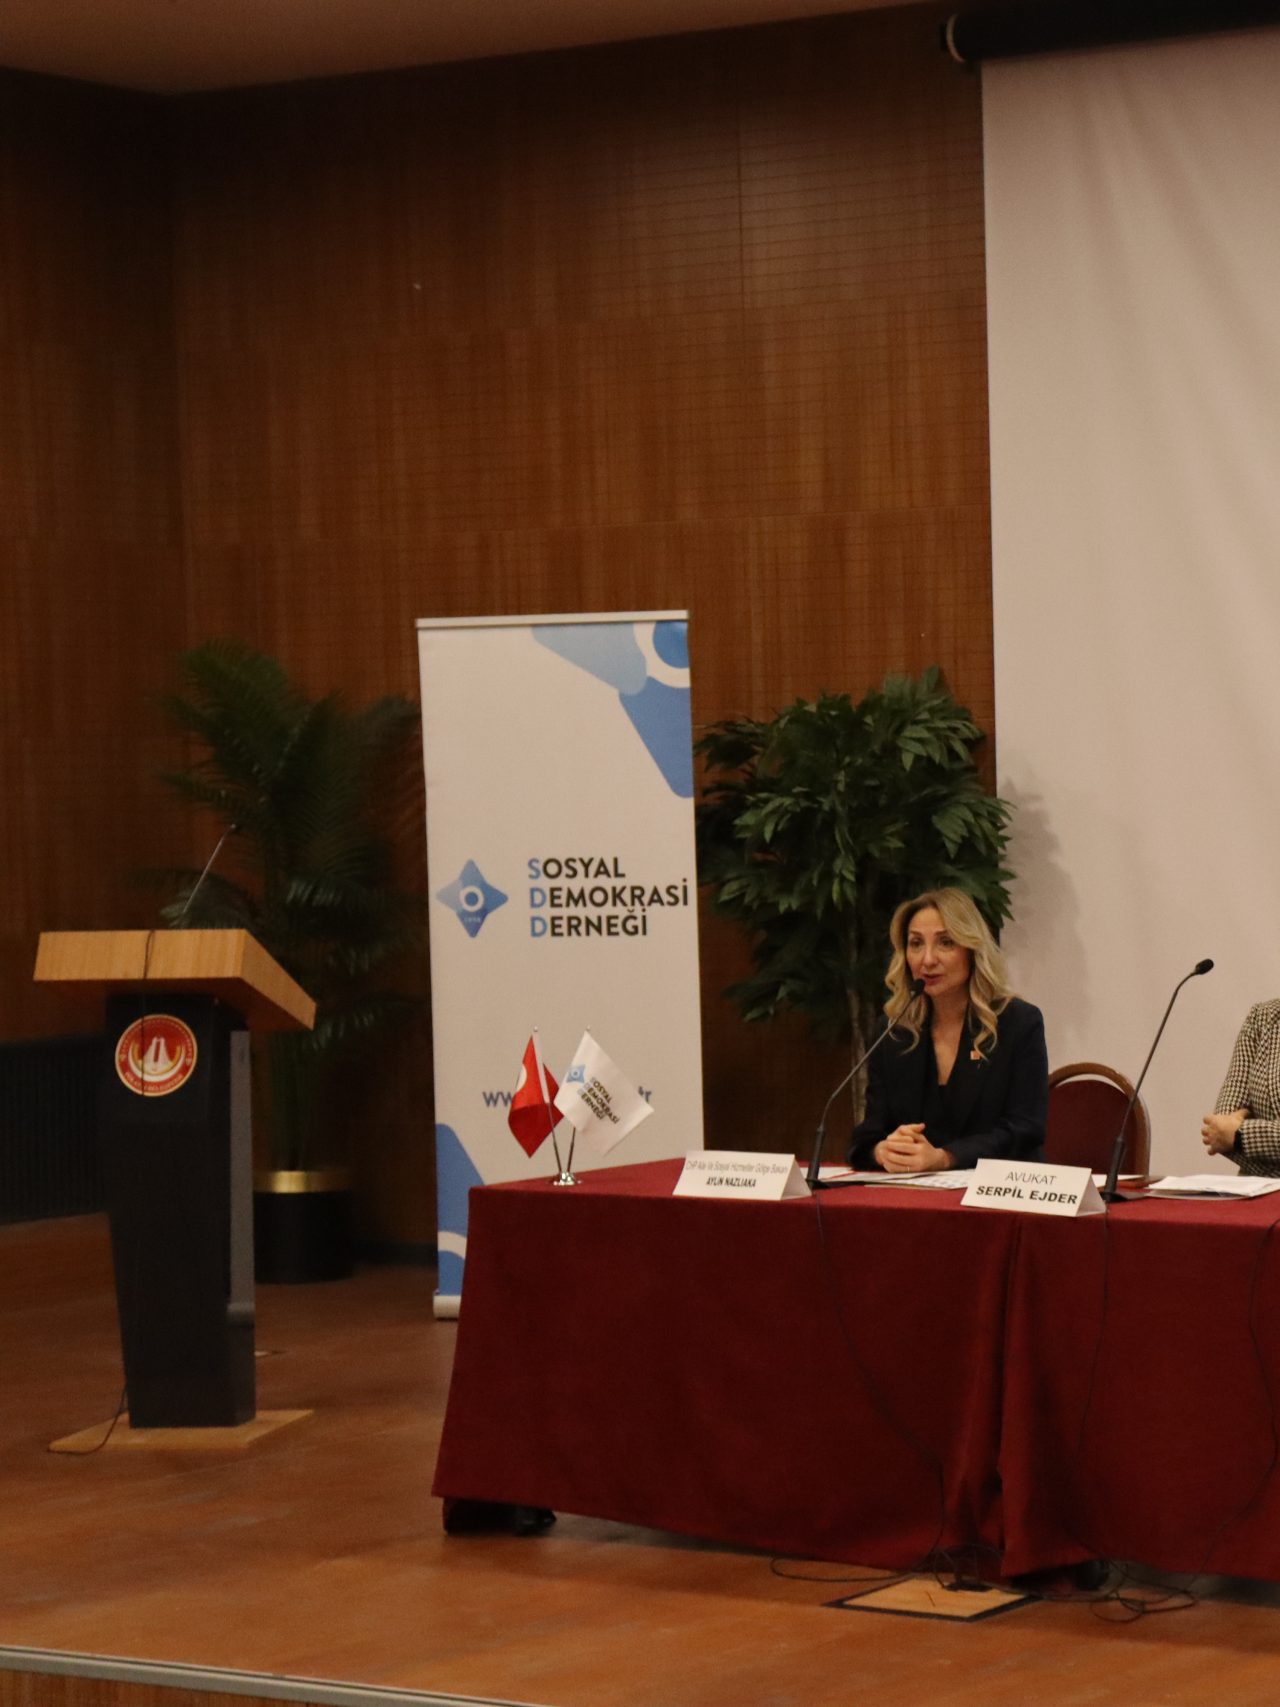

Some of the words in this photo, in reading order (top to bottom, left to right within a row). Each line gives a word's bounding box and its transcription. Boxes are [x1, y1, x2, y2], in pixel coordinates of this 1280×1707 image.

[528, 857, 625, 879] SOSYAL
[530, 878, 688, 908] DEMOKRASİ
[530, 908, 647, 937] DERNEĞİ
[1005, 1171, 1057, 1185] AVUKAT
[976, 1185, 1024, 1199] SERPİL
[1029, 1190, 1078, 1204] EJDER
